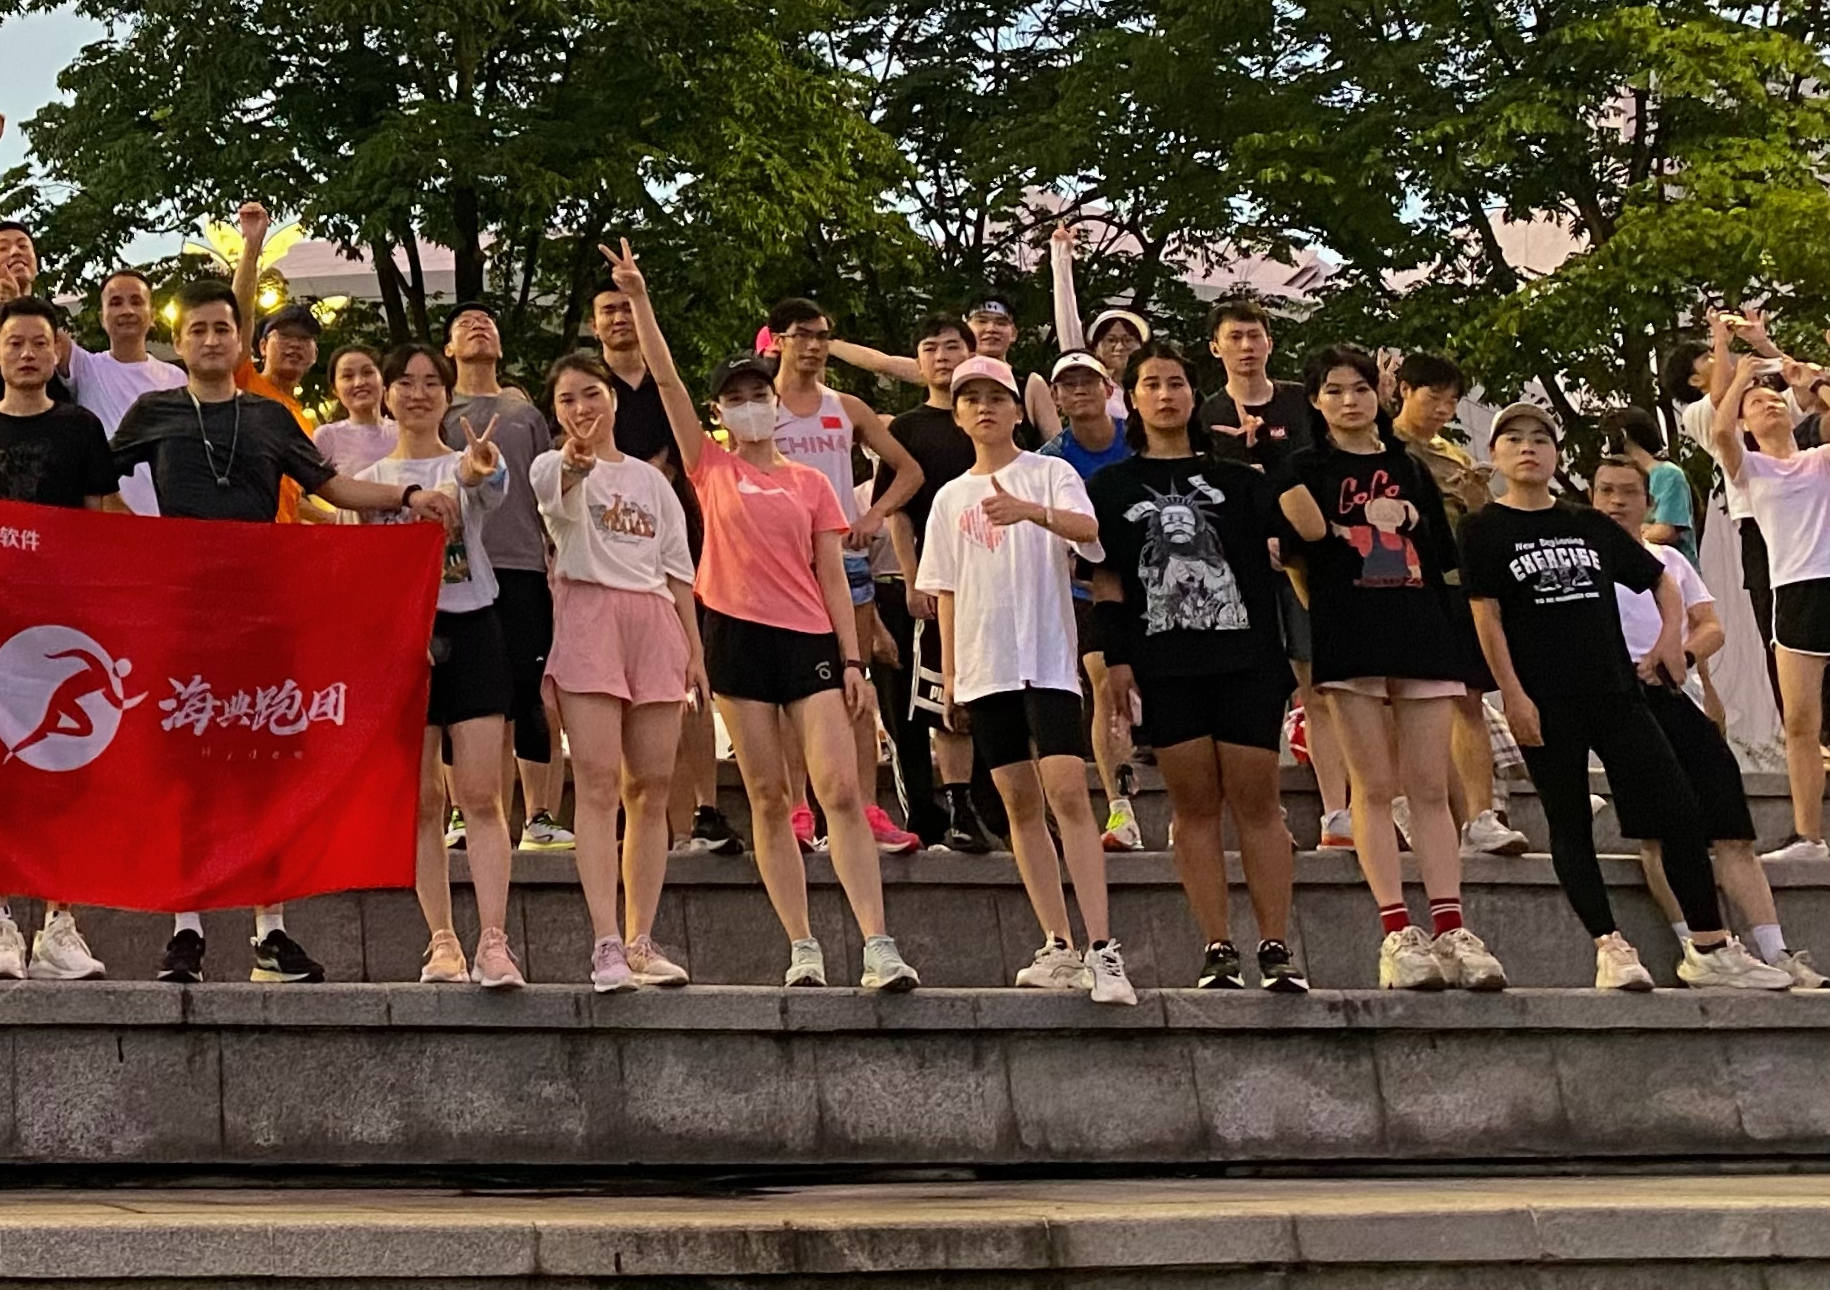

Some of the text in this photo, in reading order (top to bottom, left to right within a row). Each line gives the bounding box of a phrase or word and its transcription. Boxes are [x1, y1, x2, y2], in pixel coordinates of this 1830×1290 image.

[774, 435, 848, 455] CHINA
[1509, 548, 1601, 582] EXERCISE
[158, 674, 347, 737] 海典跑团
